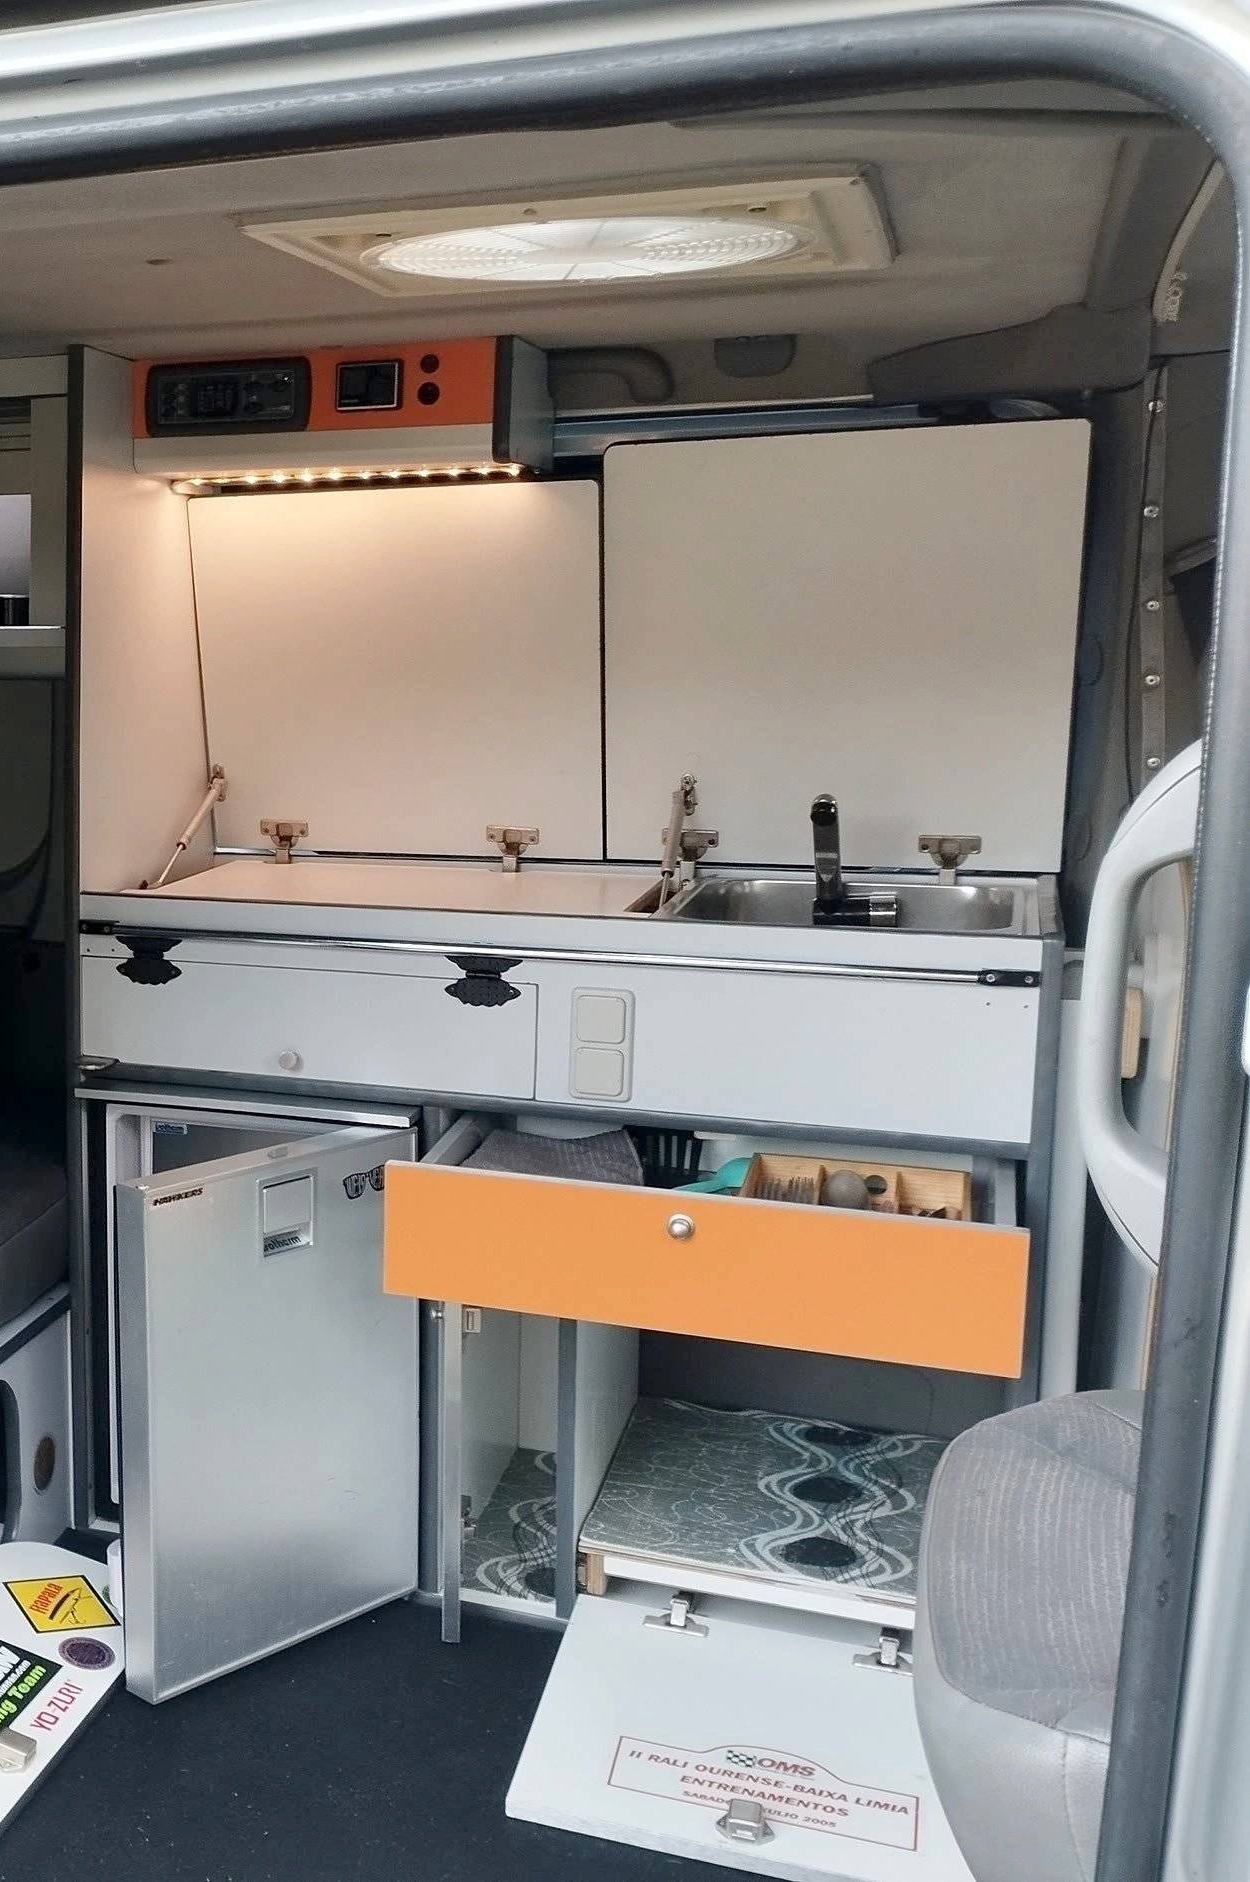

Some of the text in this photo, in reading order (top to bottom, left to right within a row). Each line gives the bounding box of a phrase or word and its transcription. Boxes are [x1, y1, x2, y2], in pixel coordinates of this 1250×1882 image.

[7, 1665, 47, 1699] Team
[30, 1682, 83, 1731] YO-ZURI
[648, 1754, 688, 1769] RALI
[695, 1764, 848, 1802] OURENSE-BAIXA
[855, 1797, 909, 1814] LIMIA
[758, 1757, 816, 1777] OMS
[681, 1775, 849, 1817] ENTRENAMENTOS
